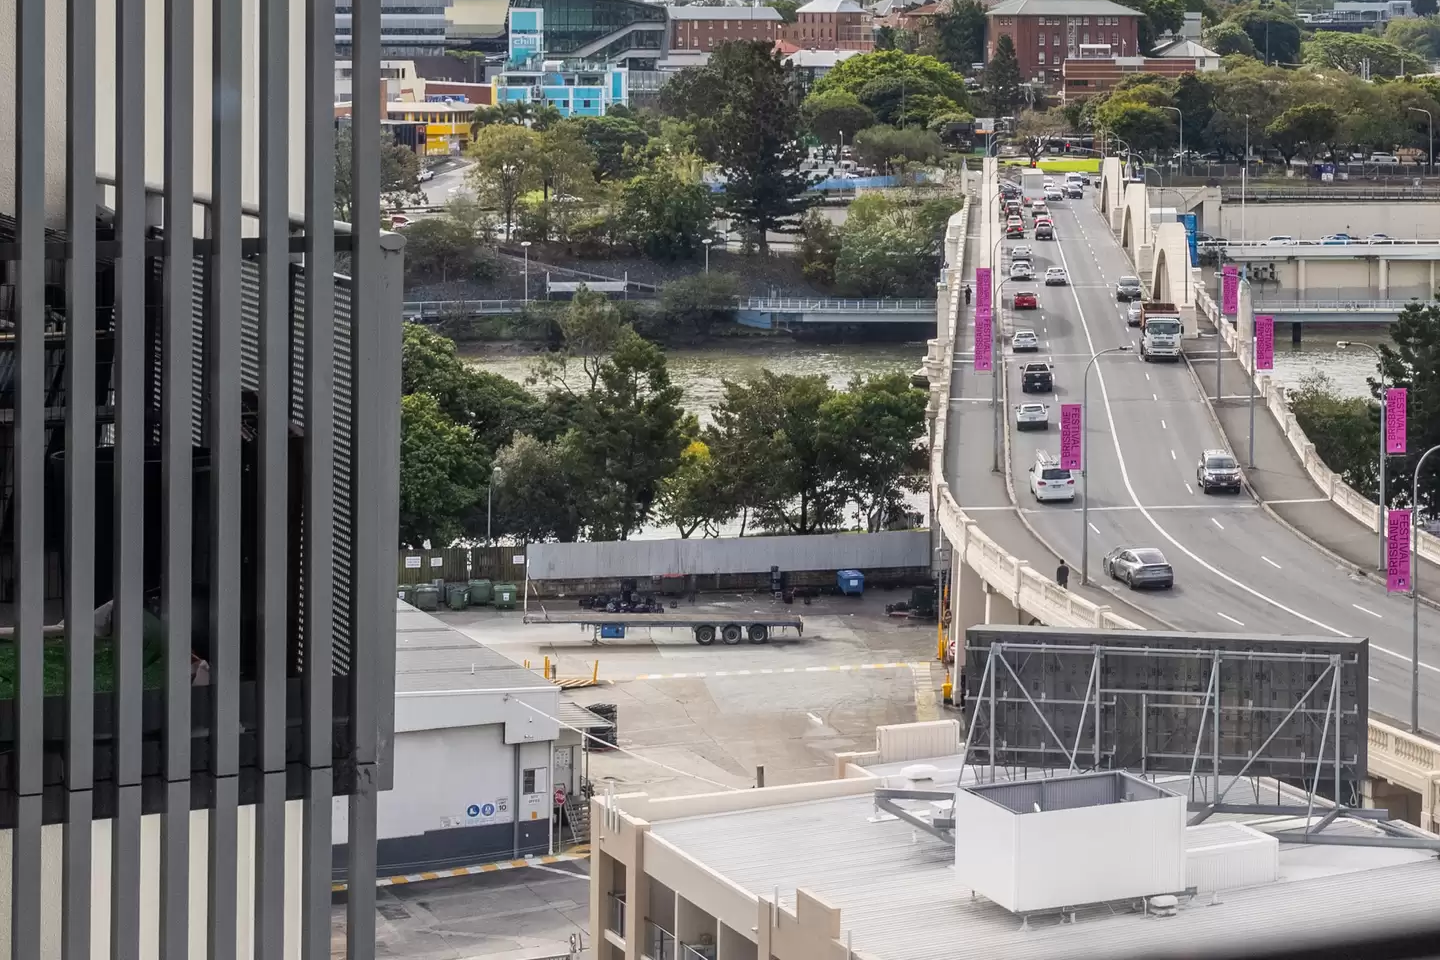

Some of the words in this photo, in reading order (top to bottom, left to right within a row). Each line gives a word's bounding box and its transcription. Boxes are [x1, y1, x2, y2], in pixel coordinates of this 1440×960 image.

[976, 321, 984, 360] BRISBANE
[983, 318, 991, 353] FESTIVAL
[1257, 321, 1265, 360] BRISBANE
[1264, 318, 1273, 352] FESTIVAL
[1071, 407, 1080, 451] FESTIVAL
[1388, 395, 1396, 441] BRISBANE
[1397, 392, 1405, 433] FESTIVAL
[1062, 411, 1071, 458] BRISBANE
[1389, 519, 1398, 576] BRISBANE
[1399, 514, 1409, 568] FESTIVAL
